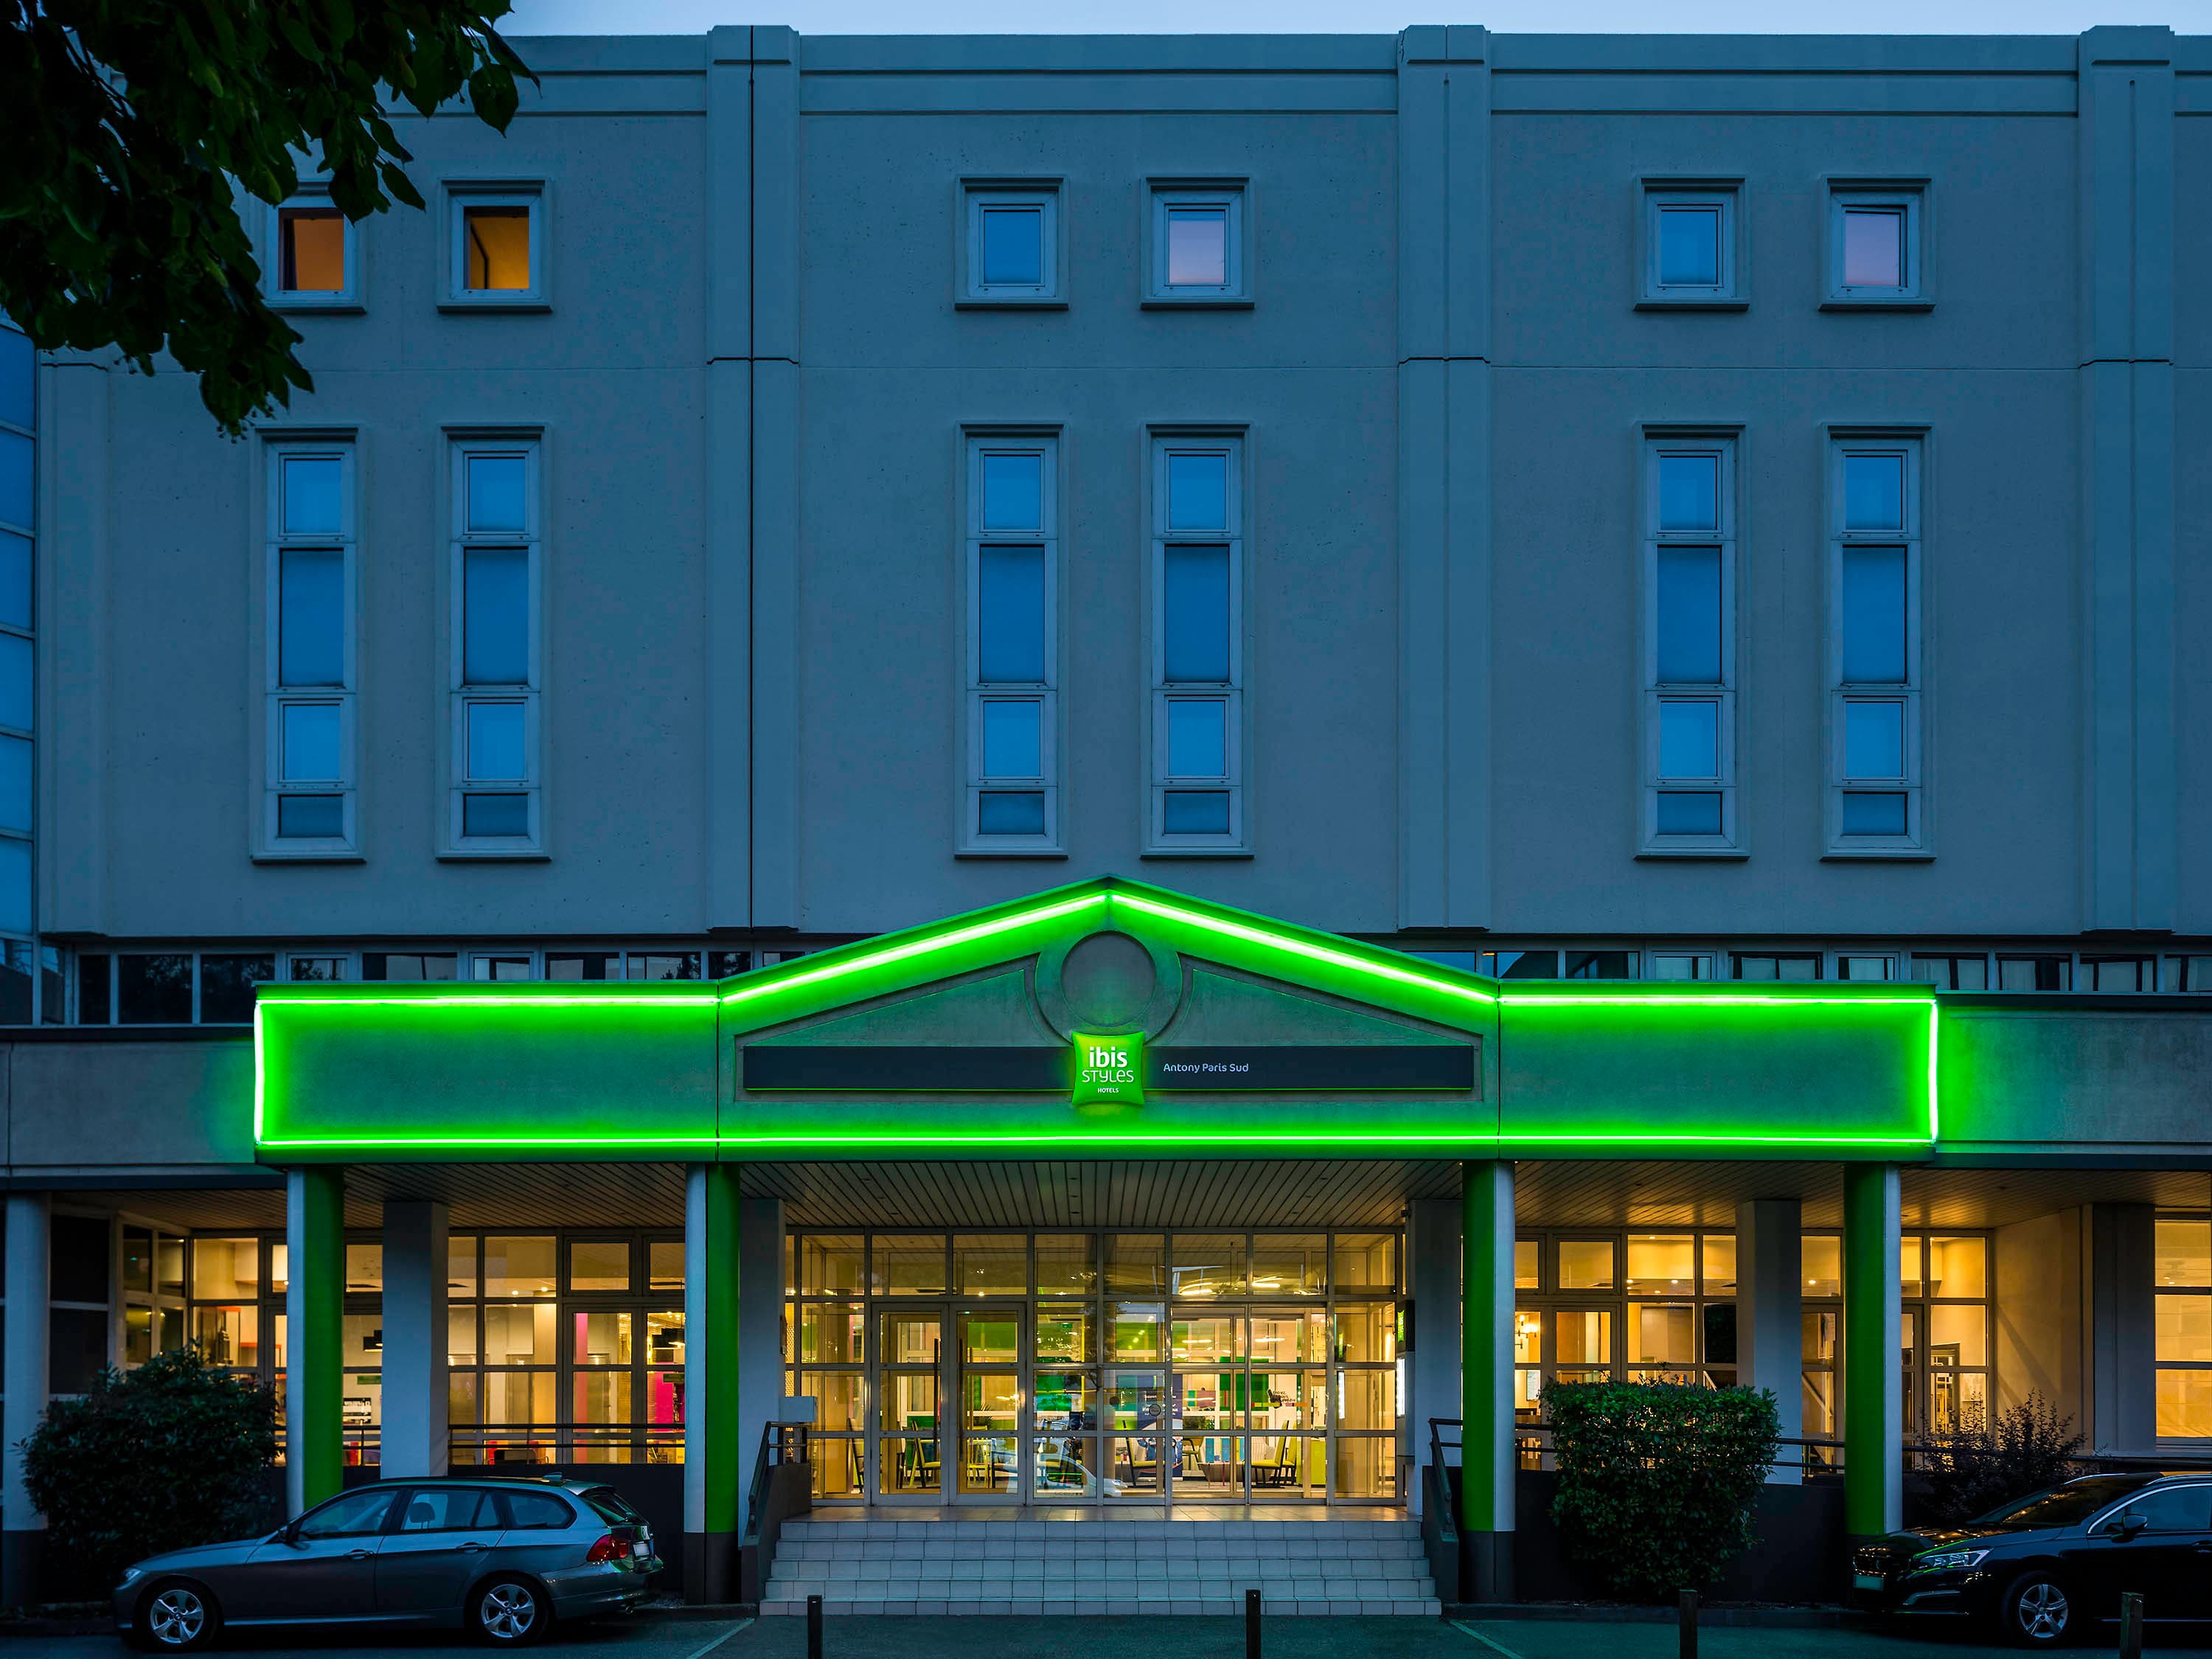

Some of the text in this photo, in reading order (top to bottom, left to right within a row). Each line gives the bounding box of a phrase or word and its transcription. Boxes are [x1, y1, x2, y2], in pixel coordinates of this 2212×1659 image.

[1090, 1046, 1127, 1068] ibis
[1164, 1063, 1249, 1073] Antony Paris Sud
